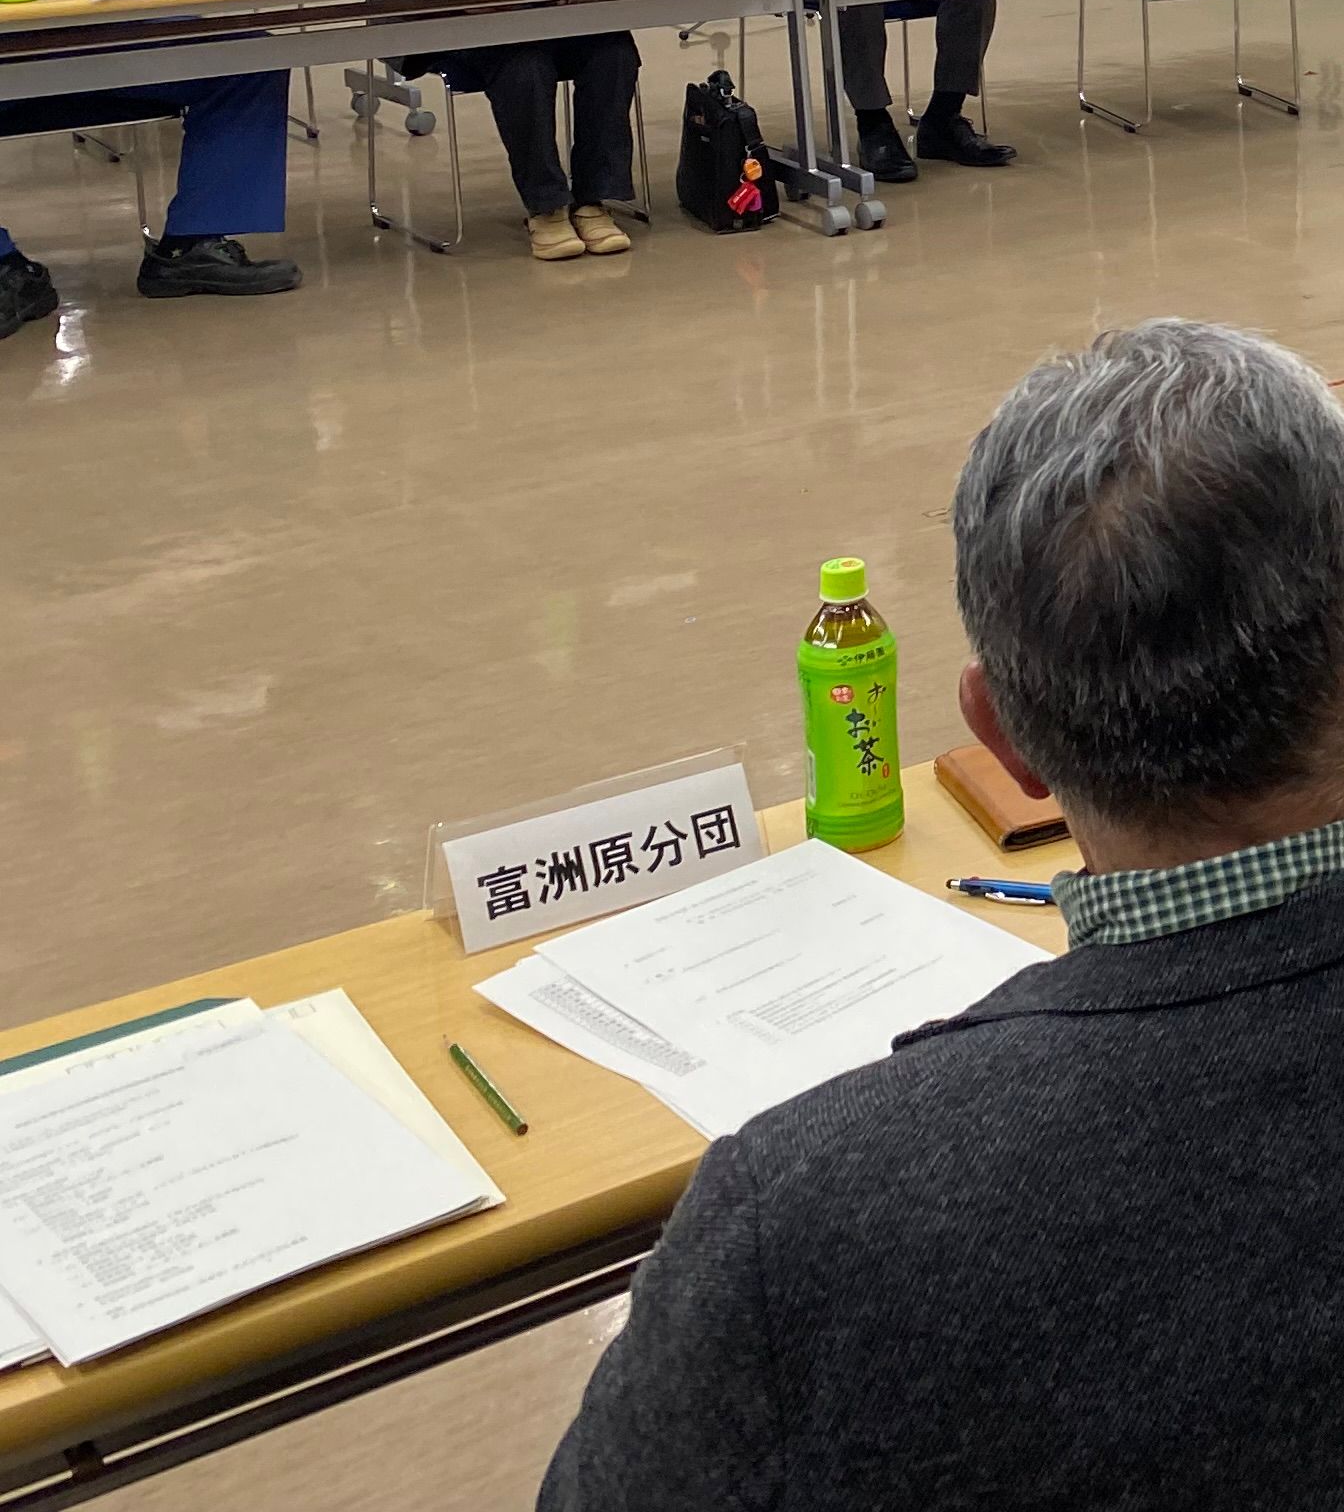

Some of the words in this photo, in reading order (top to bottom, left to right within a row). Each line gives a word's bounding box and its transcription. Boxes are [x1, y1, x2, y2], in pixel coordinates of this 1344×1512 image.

[477, 804, 741, 920] 富洲原分団
